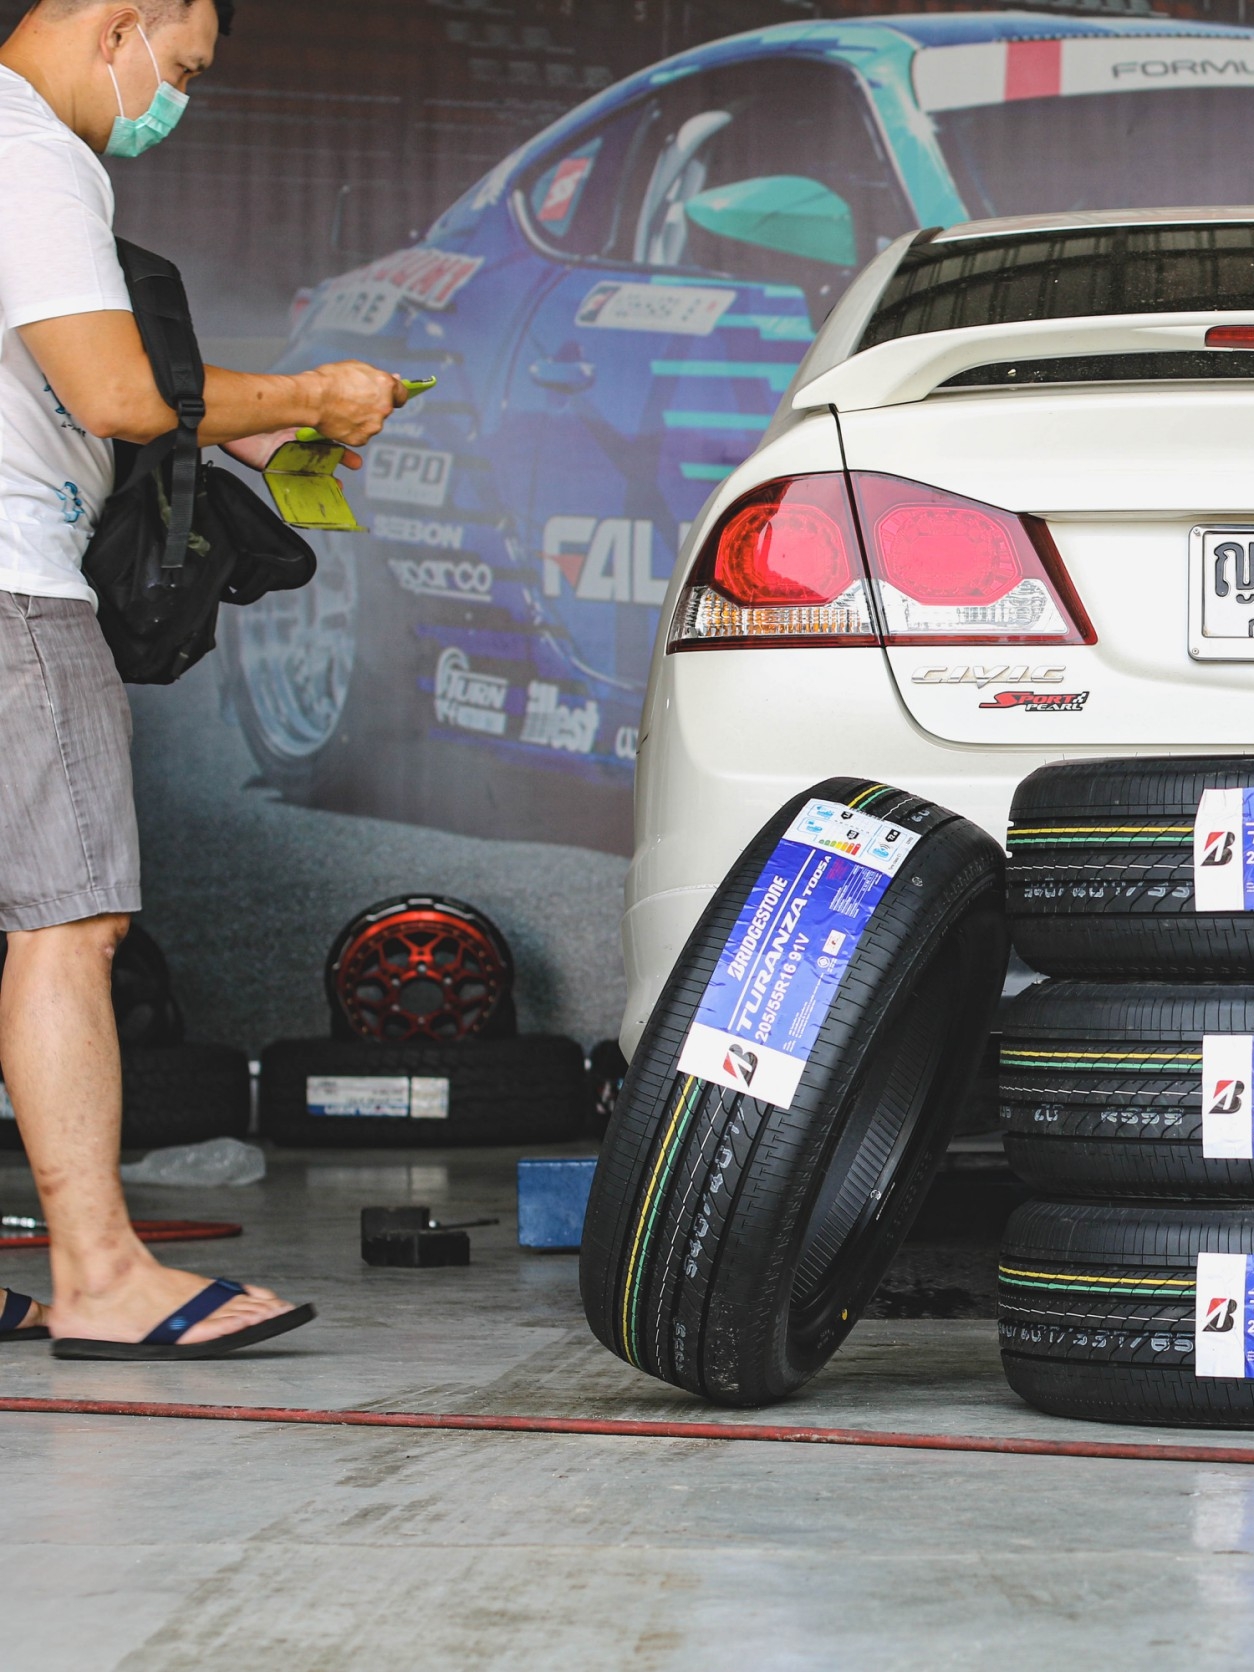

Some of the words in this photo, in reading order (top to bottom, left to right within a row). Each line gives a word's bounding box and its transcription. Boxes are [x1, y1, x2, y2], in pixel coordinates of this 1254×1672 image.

[371, 450, 445, 485] SPD
[911, 665, 1067, 689] CIVIC
[1025, 703, 1084, 712] PEARL
[727, 875, 788, 981] BRIDGESTONE
[736, 897, 808, 1032] TURANZA
[755, 963, 796, 1044] 205/55R16
[788, 933, 810, 961] 91V
